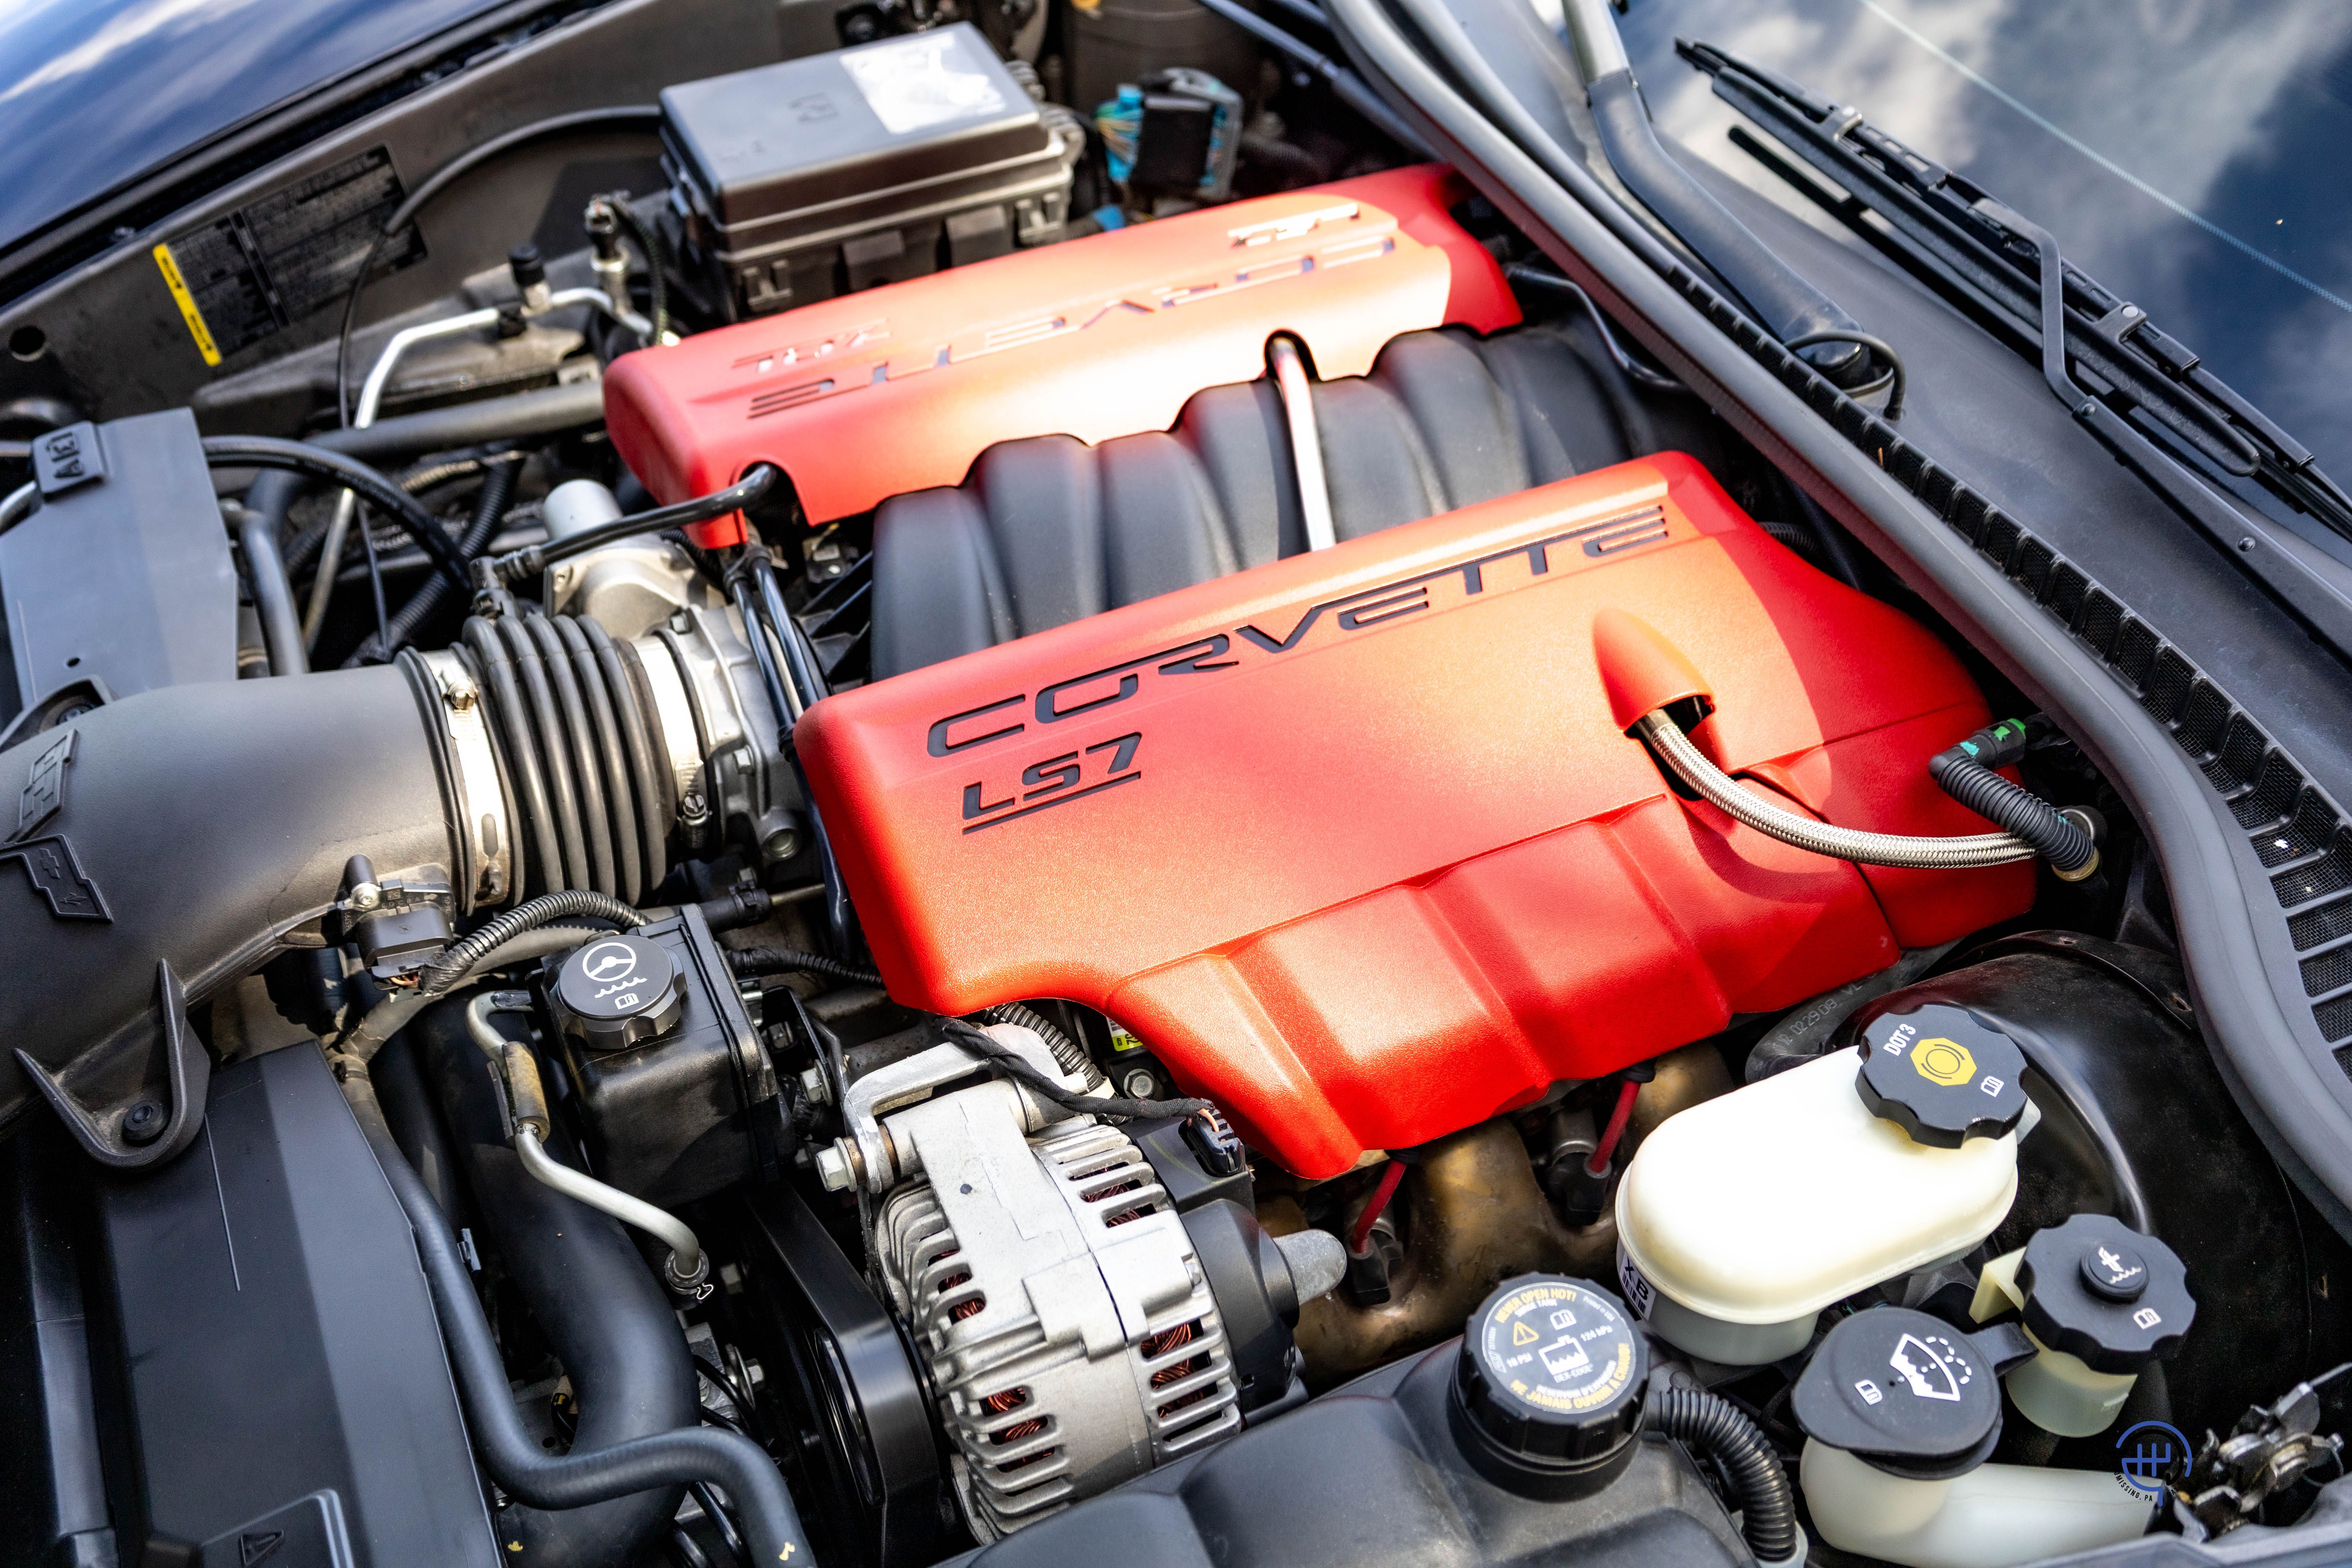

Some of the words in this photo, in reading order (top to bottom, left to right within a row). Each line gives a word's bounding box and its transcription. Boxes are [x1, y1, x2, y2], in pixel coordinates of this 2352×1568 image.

[926, 504, 1669, 758] CORVETTE
[962, 732, 1142, 820] LS7
[1883, 1030, 1912, 1057] DOT
[1900, 1023, 1917, 1035] 3
[1494, 1297, 1523, 1323] NEVER
[1520, 1288, 1549, 1304] OPEN
[1550, 1288, 1577, 1302] HOT!
